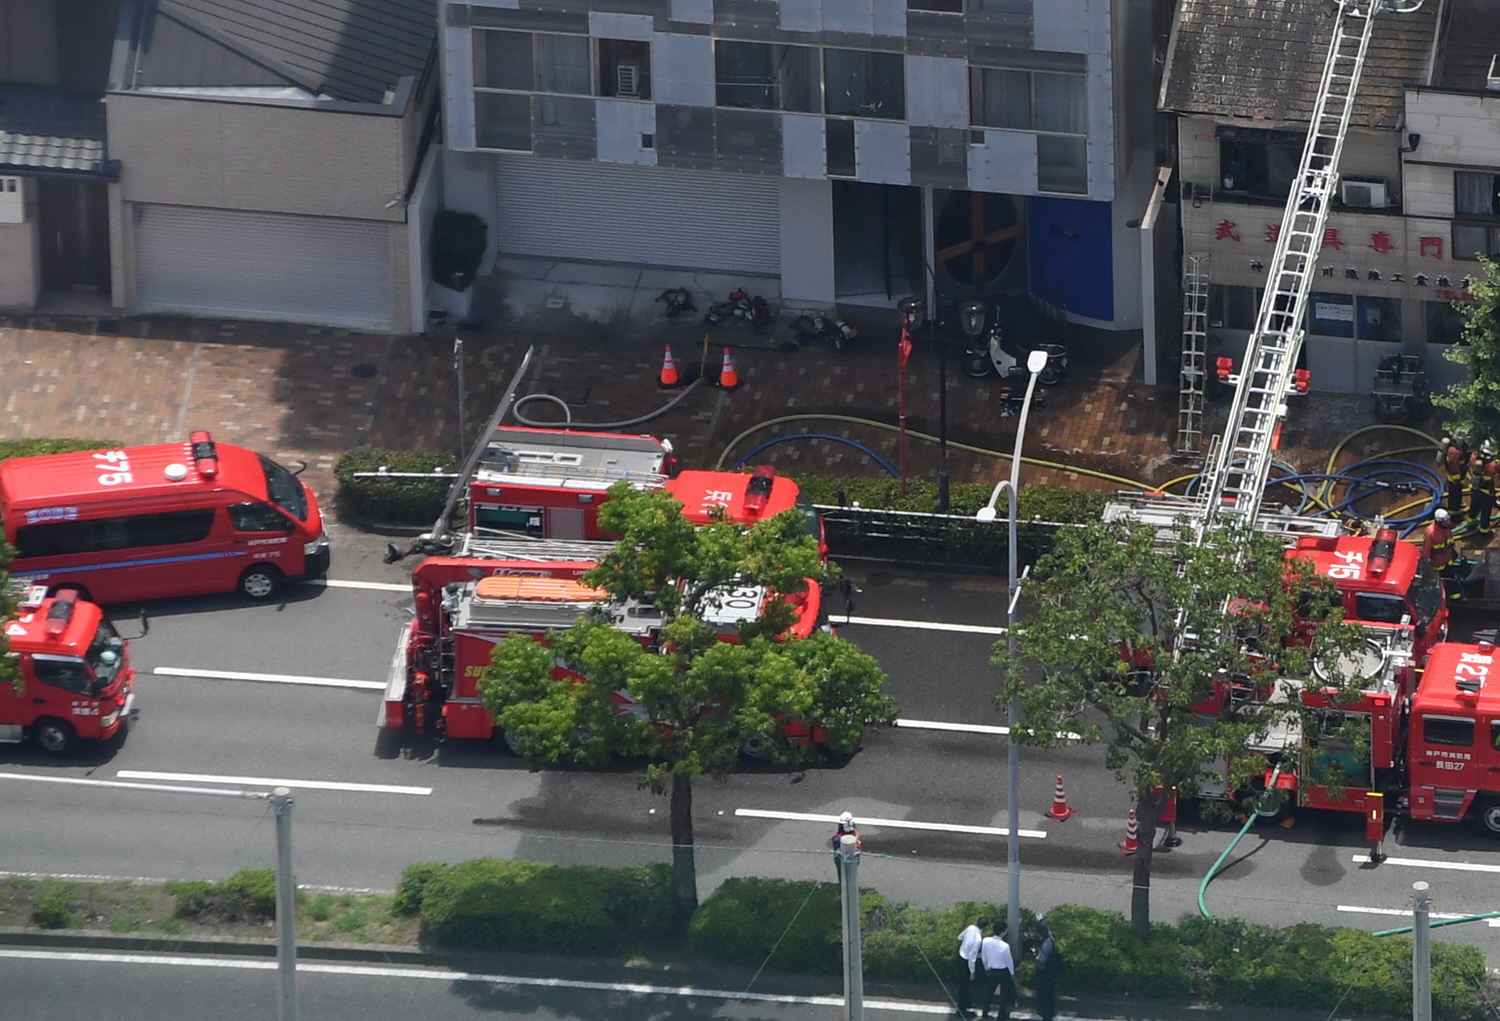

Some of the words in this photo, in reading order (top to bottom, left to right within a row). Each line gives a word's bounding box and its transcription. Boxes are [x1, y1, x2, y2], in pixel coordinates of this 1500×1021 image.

[1425, 749, 1472, 761] 神戸市消防局
[1435, 760, 1465, 771] 長田27
